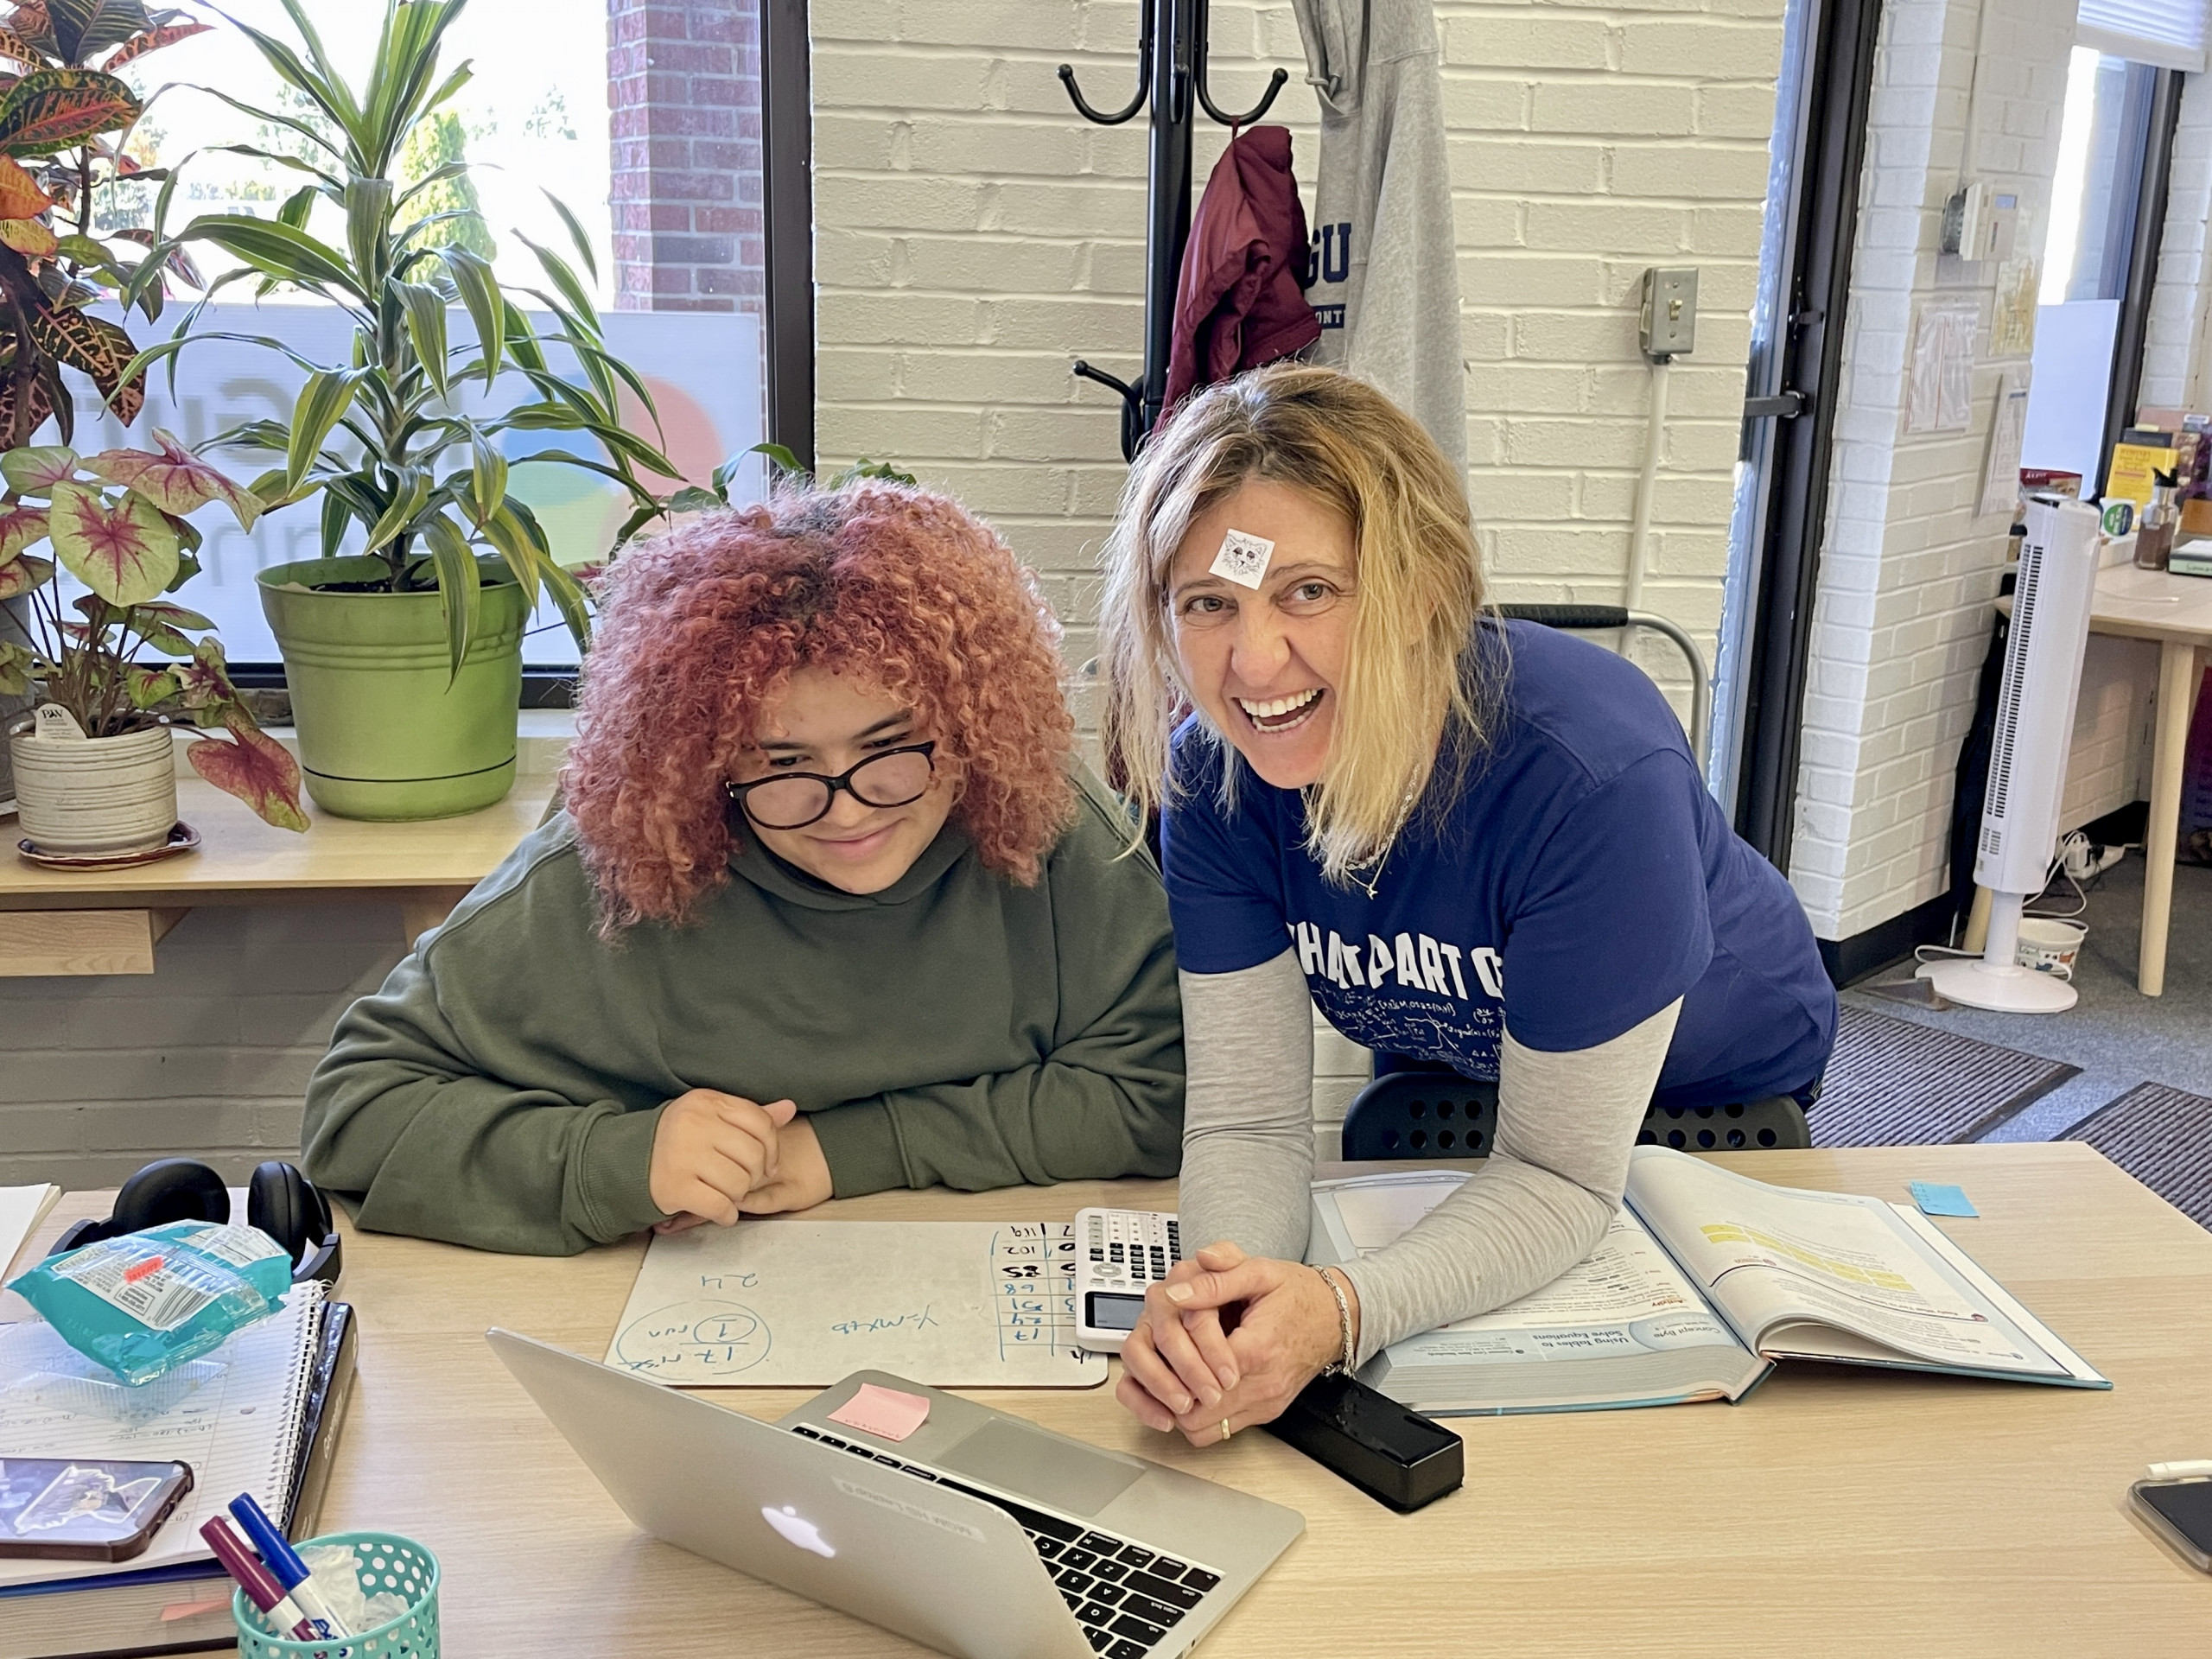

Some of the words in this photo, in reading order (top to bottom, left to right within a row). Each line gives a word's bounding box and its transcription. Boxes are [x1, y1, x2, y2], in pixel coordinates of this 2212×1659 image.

[1368, 932, 1469, 1000] PART
[1471, 946, 1506, 1002] O
[1002, 1245, 1035, 1255] 102
[1592, 1330, 1624, 1338] Solve
[1677, 1325, 1721, 1338] Concept
[1556, 1339, 1592, 1348] Tables
[1595, 1336, 1629, 1344] Using
